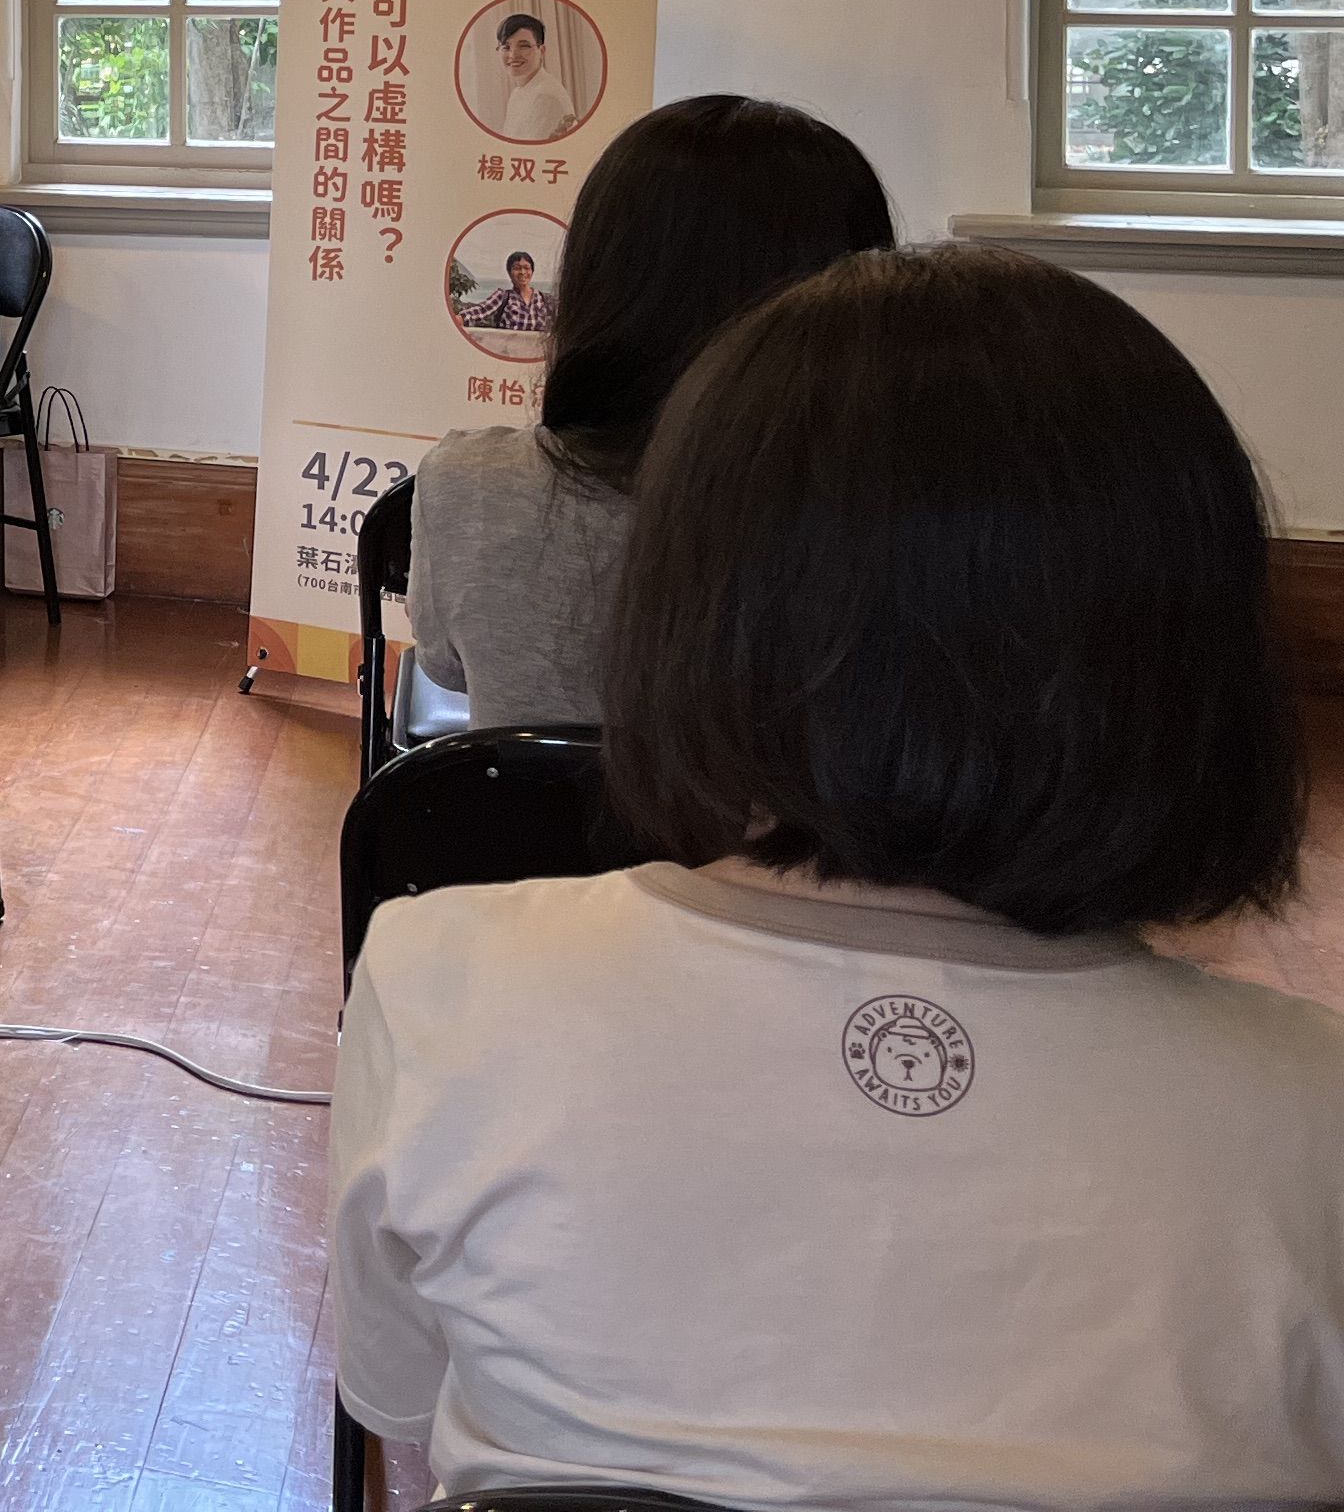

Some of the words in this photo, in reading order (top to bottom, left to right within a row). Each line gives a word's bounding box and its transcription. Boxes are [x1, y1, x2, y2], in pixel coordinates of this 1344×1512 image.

[477, 154, 569, 184] 楊双子
[854, 1001, 964, 1049] ADVENTURE
[855, 1068, 921, 1111] AWAITS
[928, 1076, 961, 1107] YOU
